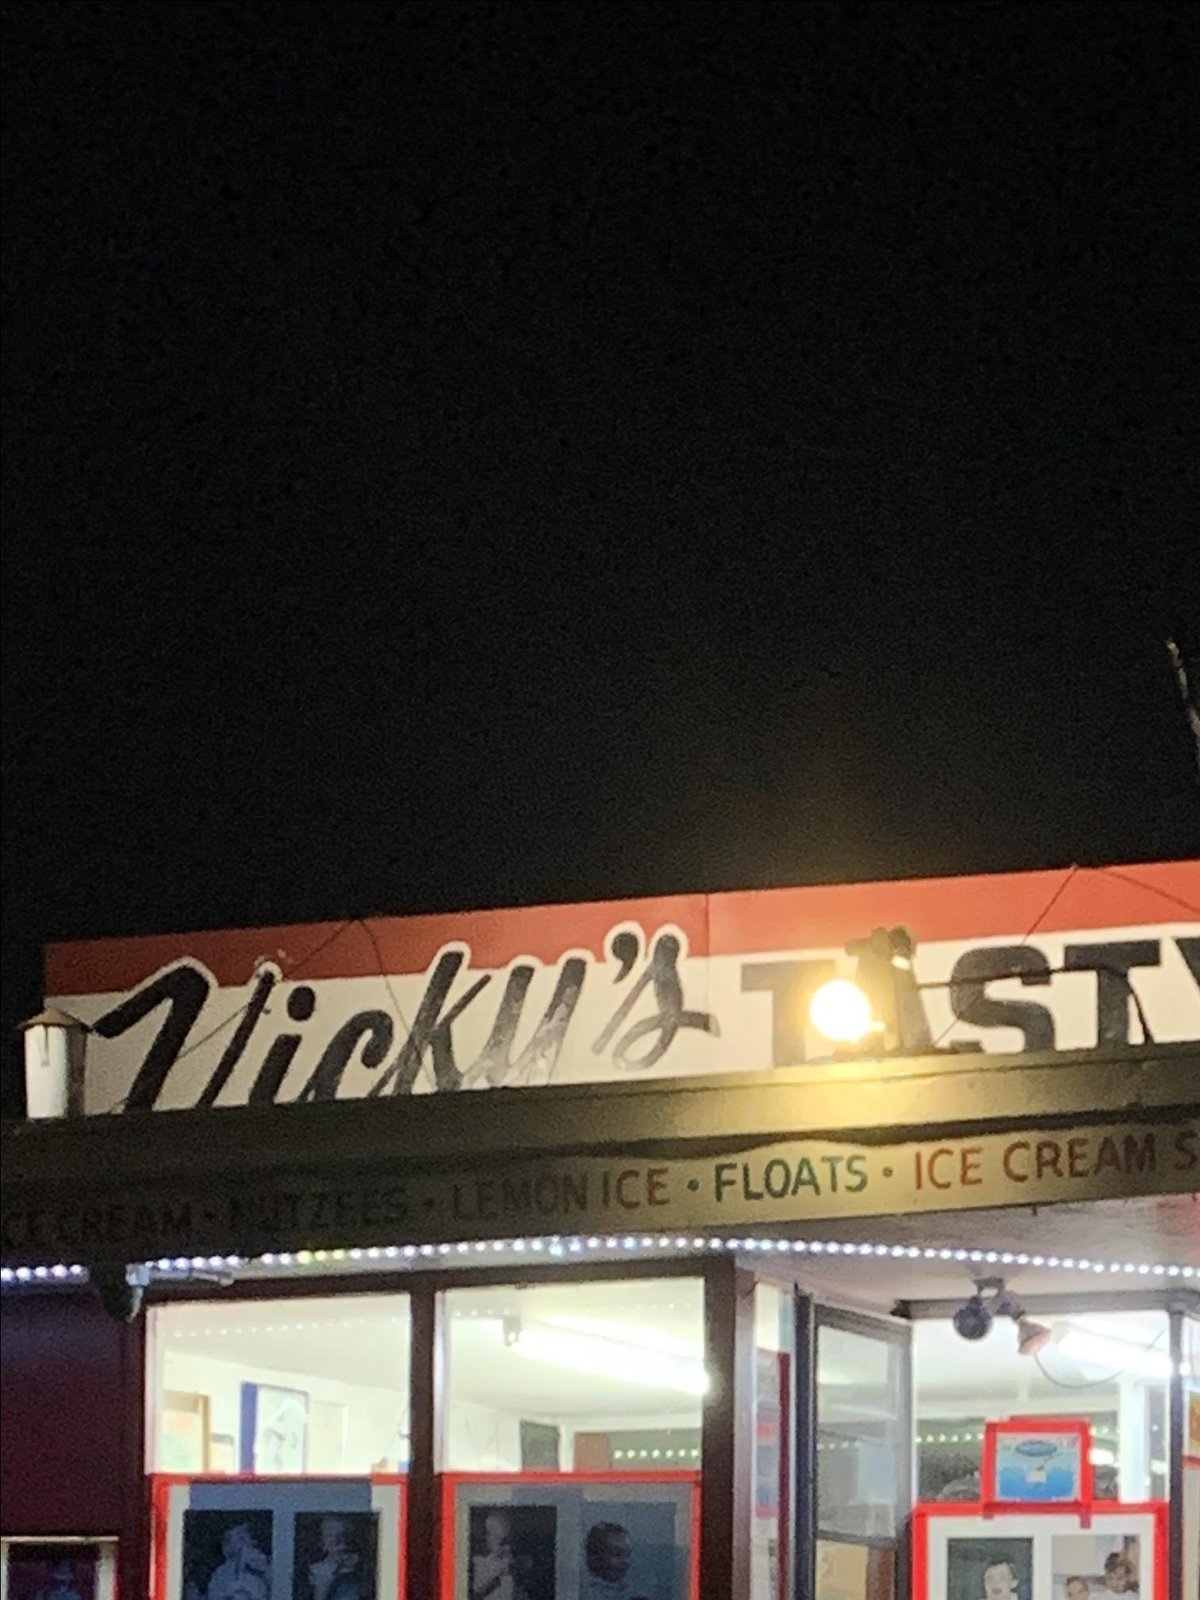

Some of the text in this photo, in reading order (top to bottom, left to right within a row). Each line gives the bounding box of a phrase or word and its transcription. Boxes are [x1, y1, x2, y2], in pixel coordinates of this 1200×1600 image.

[92, 922, 722, 1113] Vicky's
[451, 1172, 588, 1222] LEMON
[602, 1167, 671, 1209] ICE
[713, 1155, 868, 1201] FLOATS
[914, 1145, 984, 1190] ICE
[1002, 1133, 1156, 1184] CREAM
